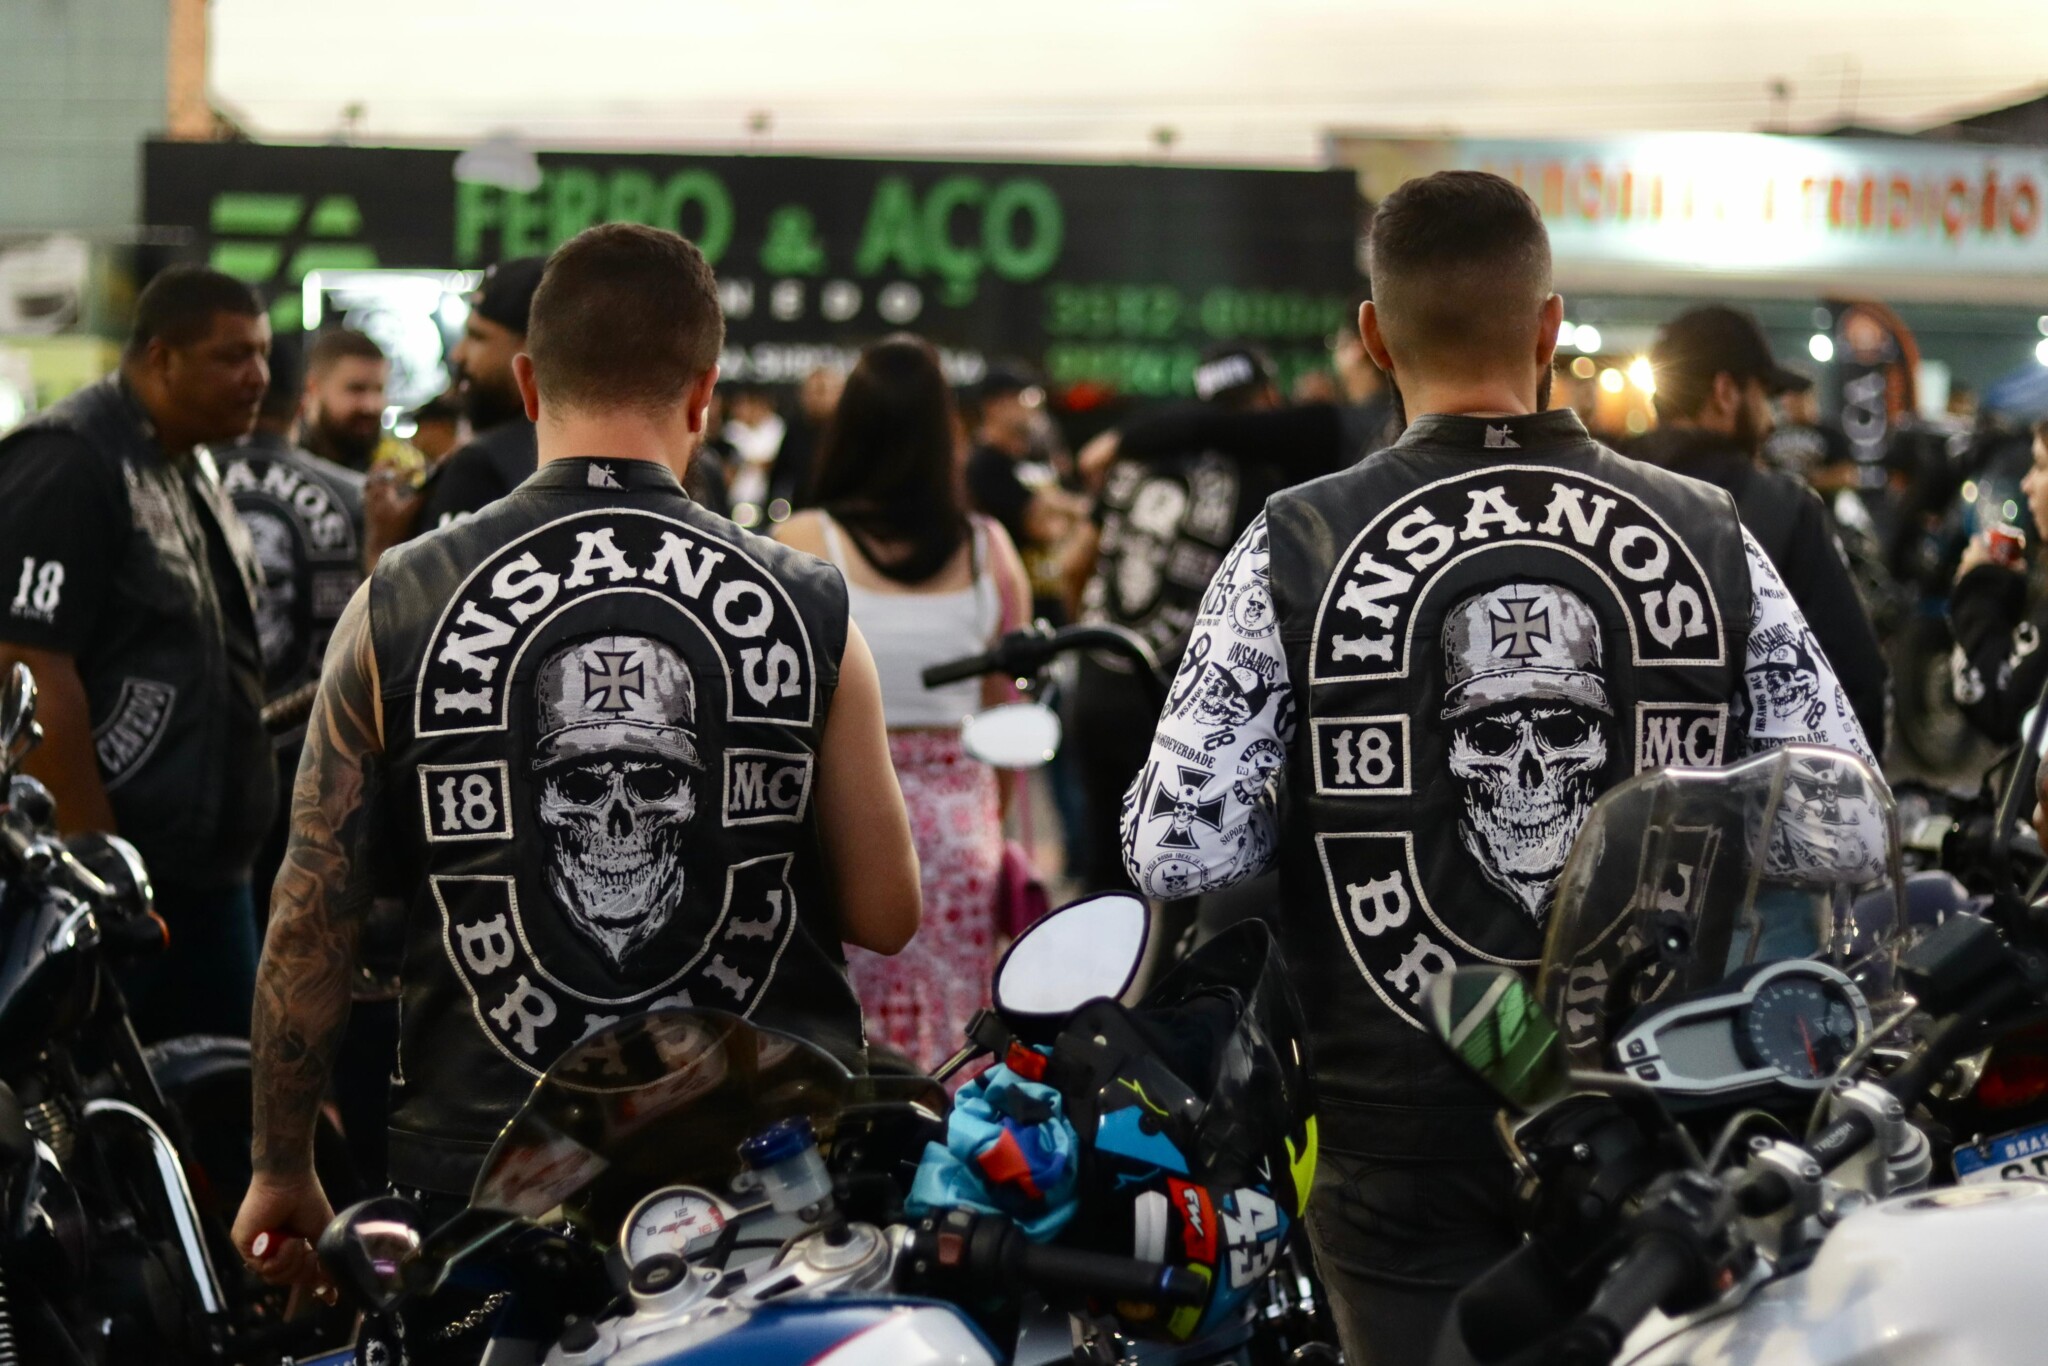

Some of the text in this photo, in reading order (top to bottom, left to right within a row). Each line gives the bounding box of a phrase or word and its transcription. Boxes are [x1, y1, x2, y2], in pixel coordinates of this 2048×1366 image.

[854, 175, 1065, 305] AÇO
[13, 556, 64, 612] 18
[1332, 482, 1709, 663] INSANOS
[434, 527, 802, 716] INSANOS
[1227, 641, 1280, 681] INSANOS
[1754, 694, 1767, 732] INSANOS
[1332, 728, 1396, 785] 18
[1642, 715, 1718, 768] MC
[437, 773, 498, 831] 18
[729, 761, 804, 812] MC
